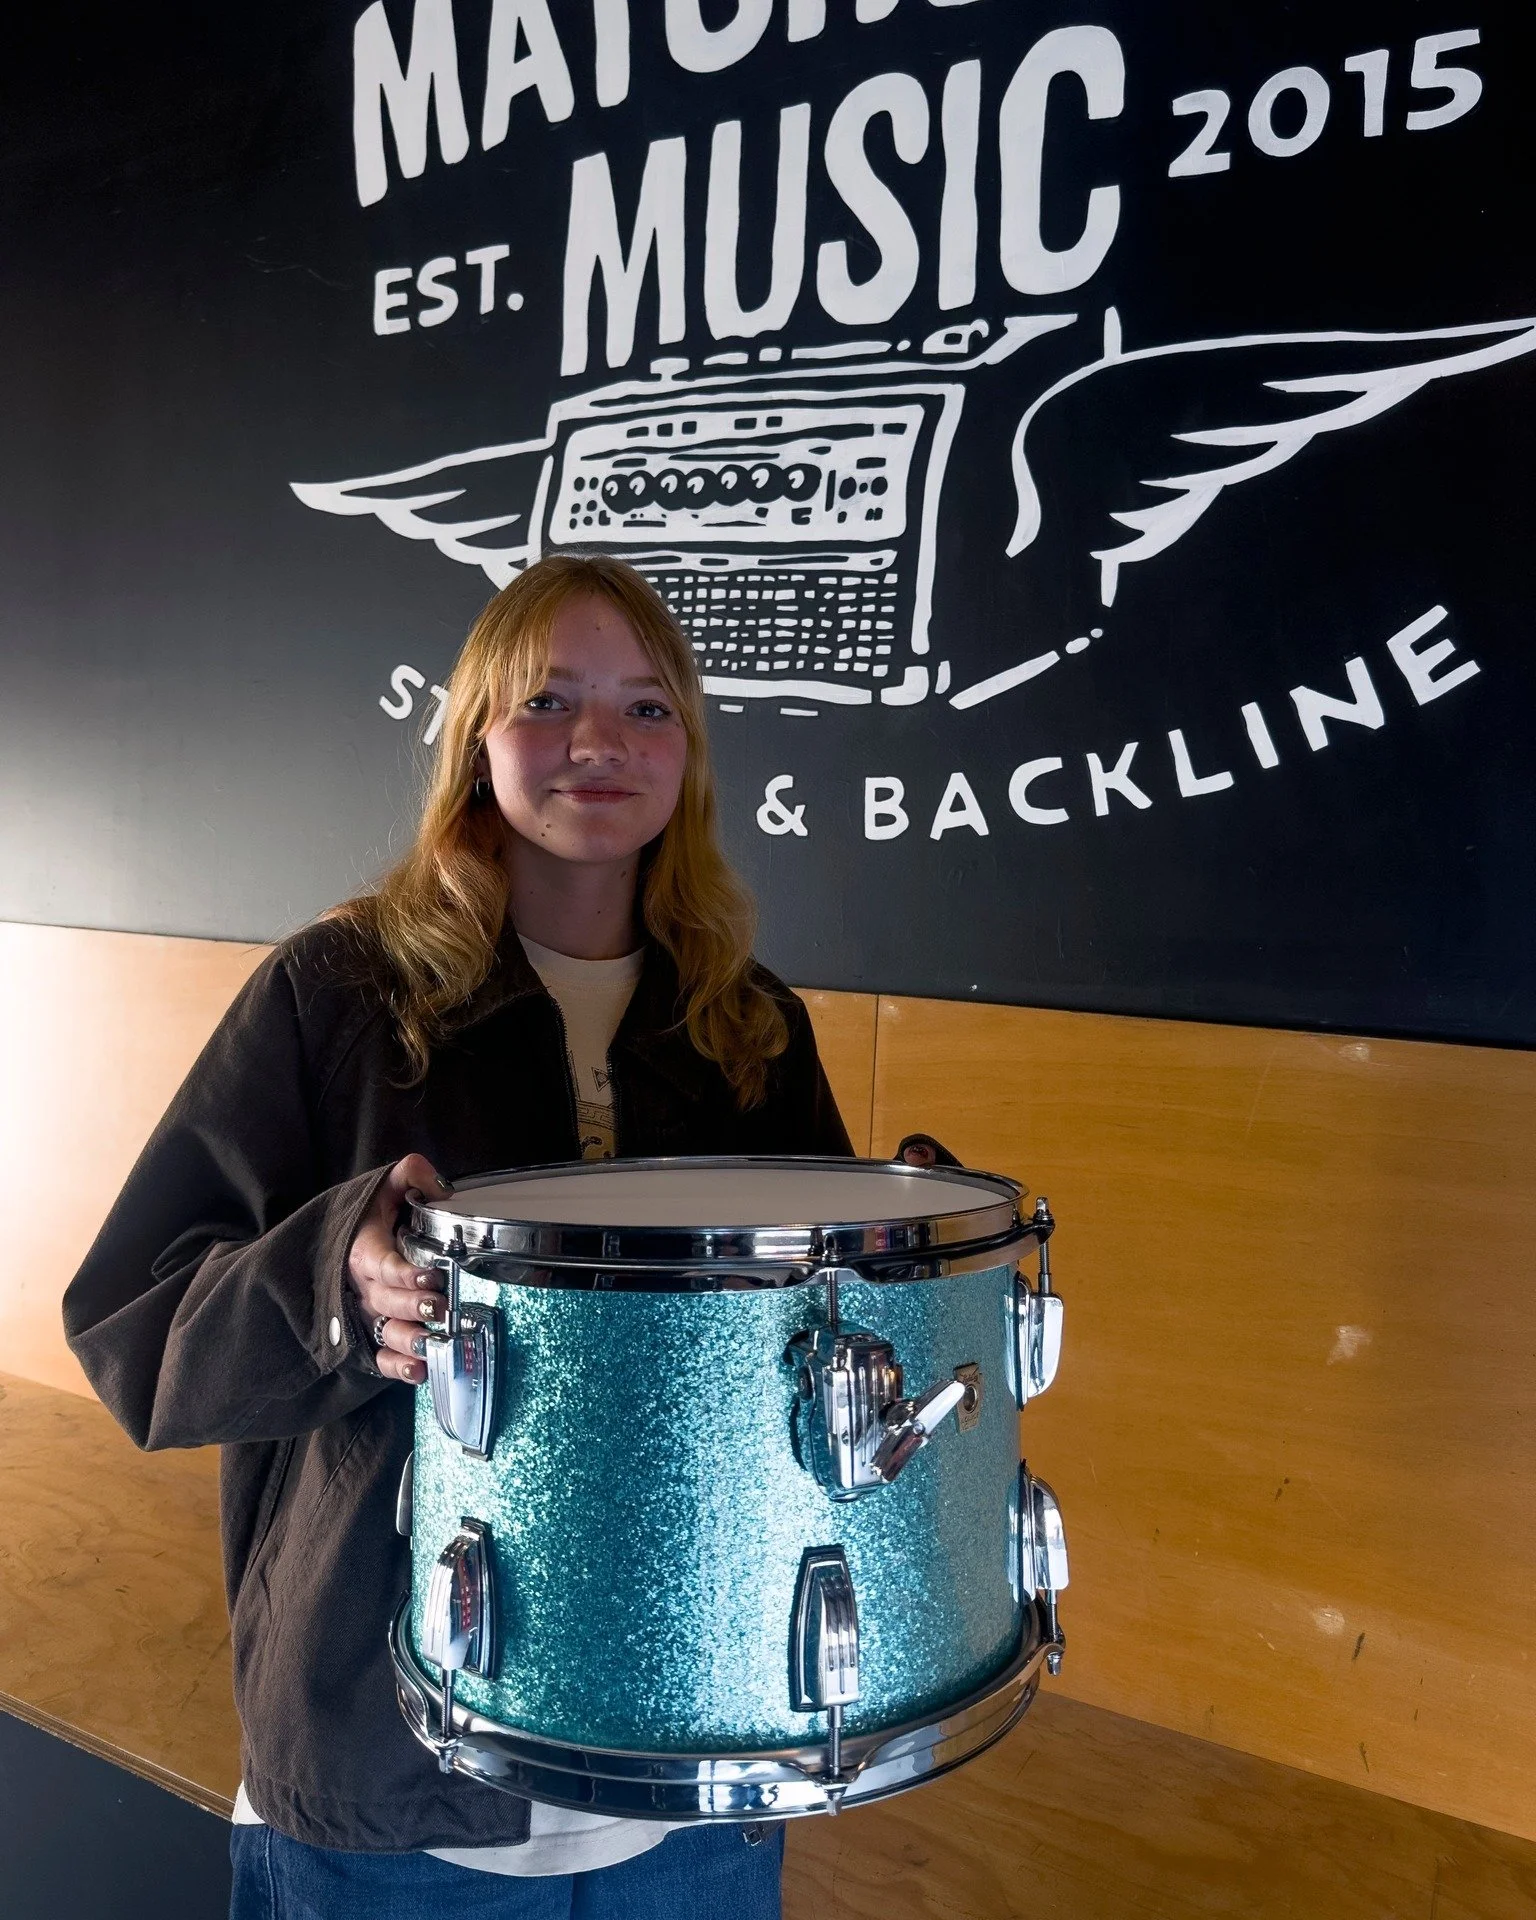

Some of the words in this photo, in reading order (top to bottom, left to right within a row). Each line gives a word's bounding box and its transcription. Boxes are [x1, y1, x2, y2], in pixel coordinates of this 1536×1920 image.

[1169, 29, 1482, 177] 2015
[374, 245, 523, 335] EST.
[561, 25, 1125, 376] MUSIC
[756, 774, 809, 838] &
[865, 605, 1481, 841] BACKLINE
